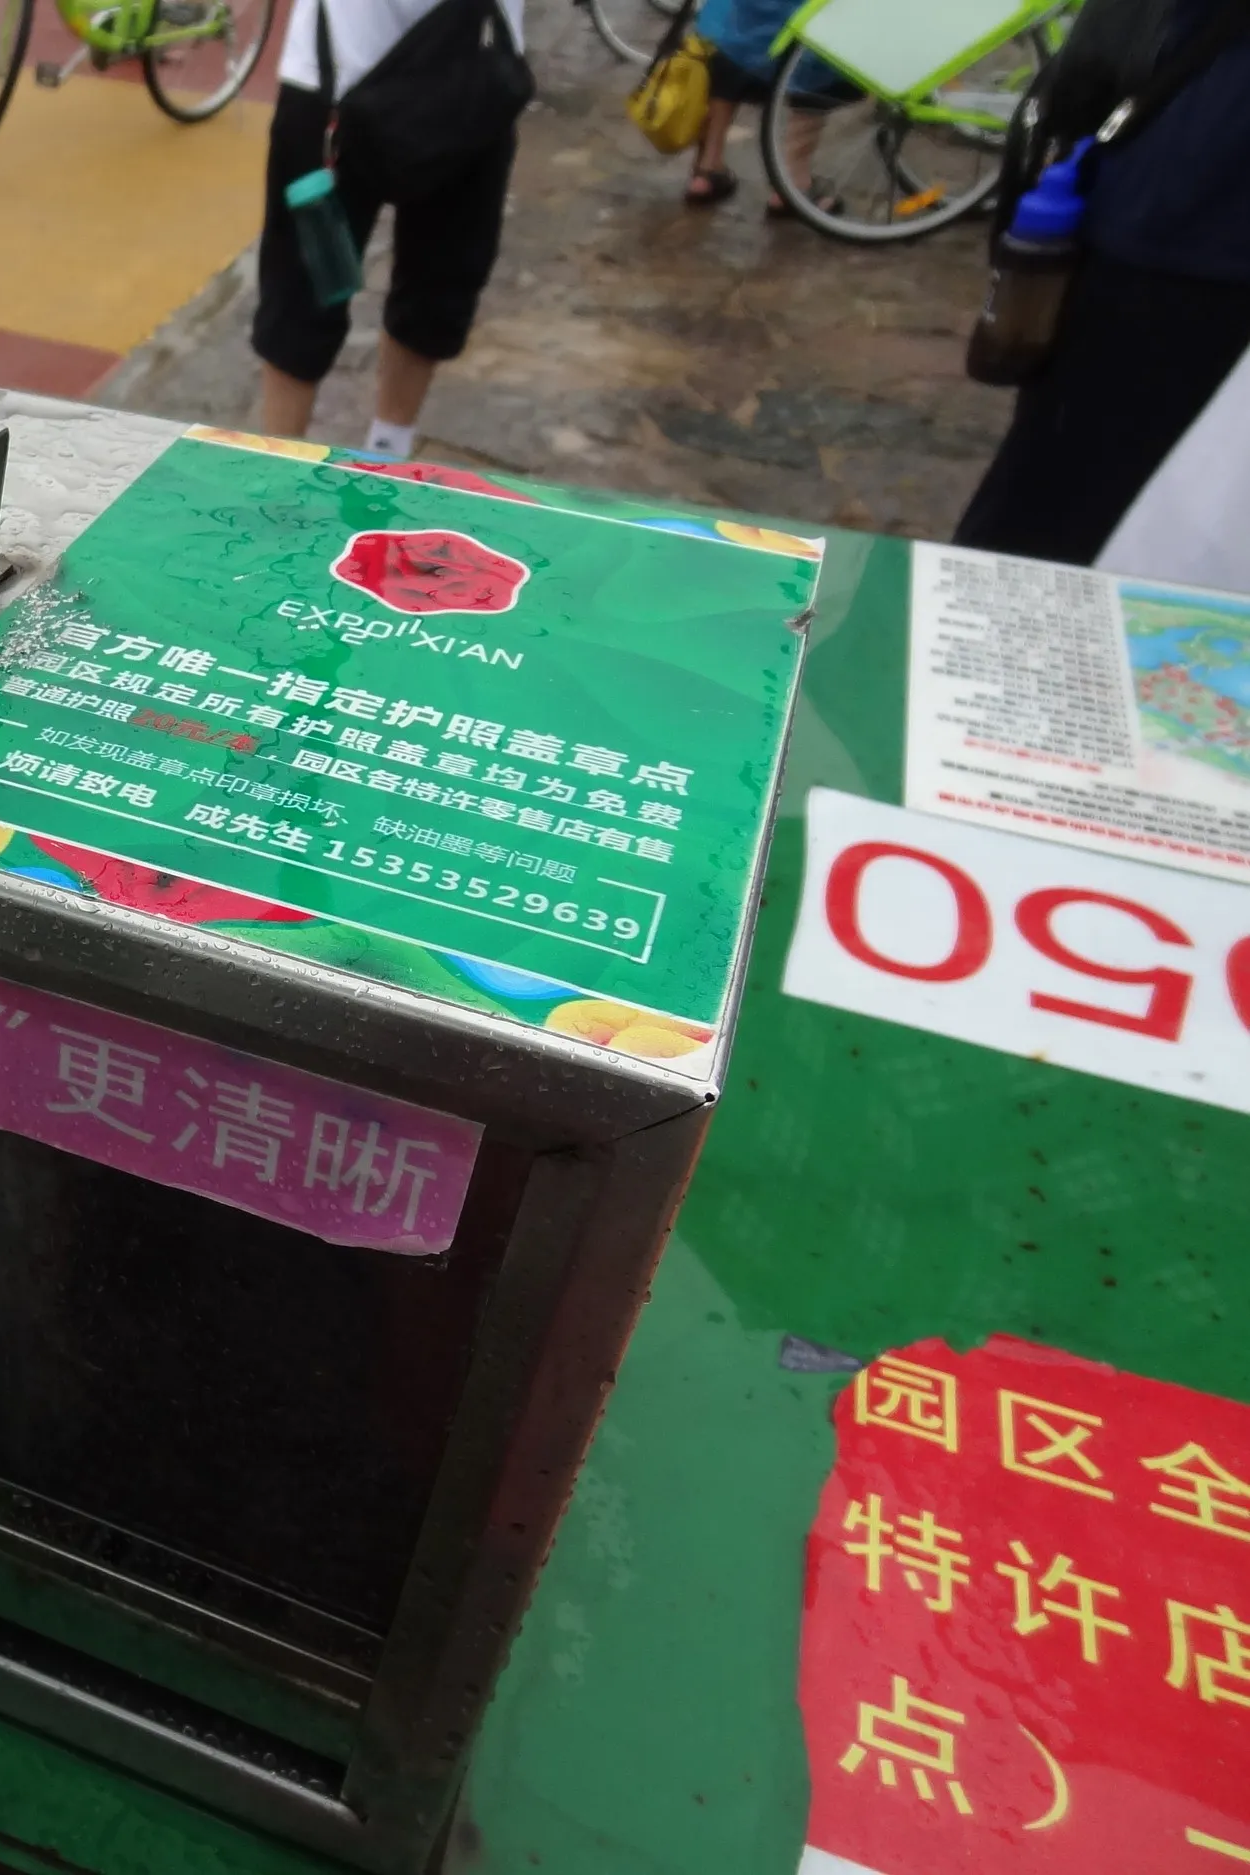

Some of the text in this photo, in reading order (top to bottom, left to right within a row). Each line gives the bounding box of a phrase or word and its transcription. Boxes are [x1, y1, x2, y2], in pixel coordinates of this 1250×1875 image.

[31, 651, 683, 831] 园区规定所有护照盖章均为免费
[56, 621, 694, 796] 官方唯一指定护照盖章点
[184, 803, 313, 853] 成先生
[322, 839, 641, 941] 15353529639
[825, 840, 1250, 1043] 50
[855, 1354, 1250, 1541] 园区全
